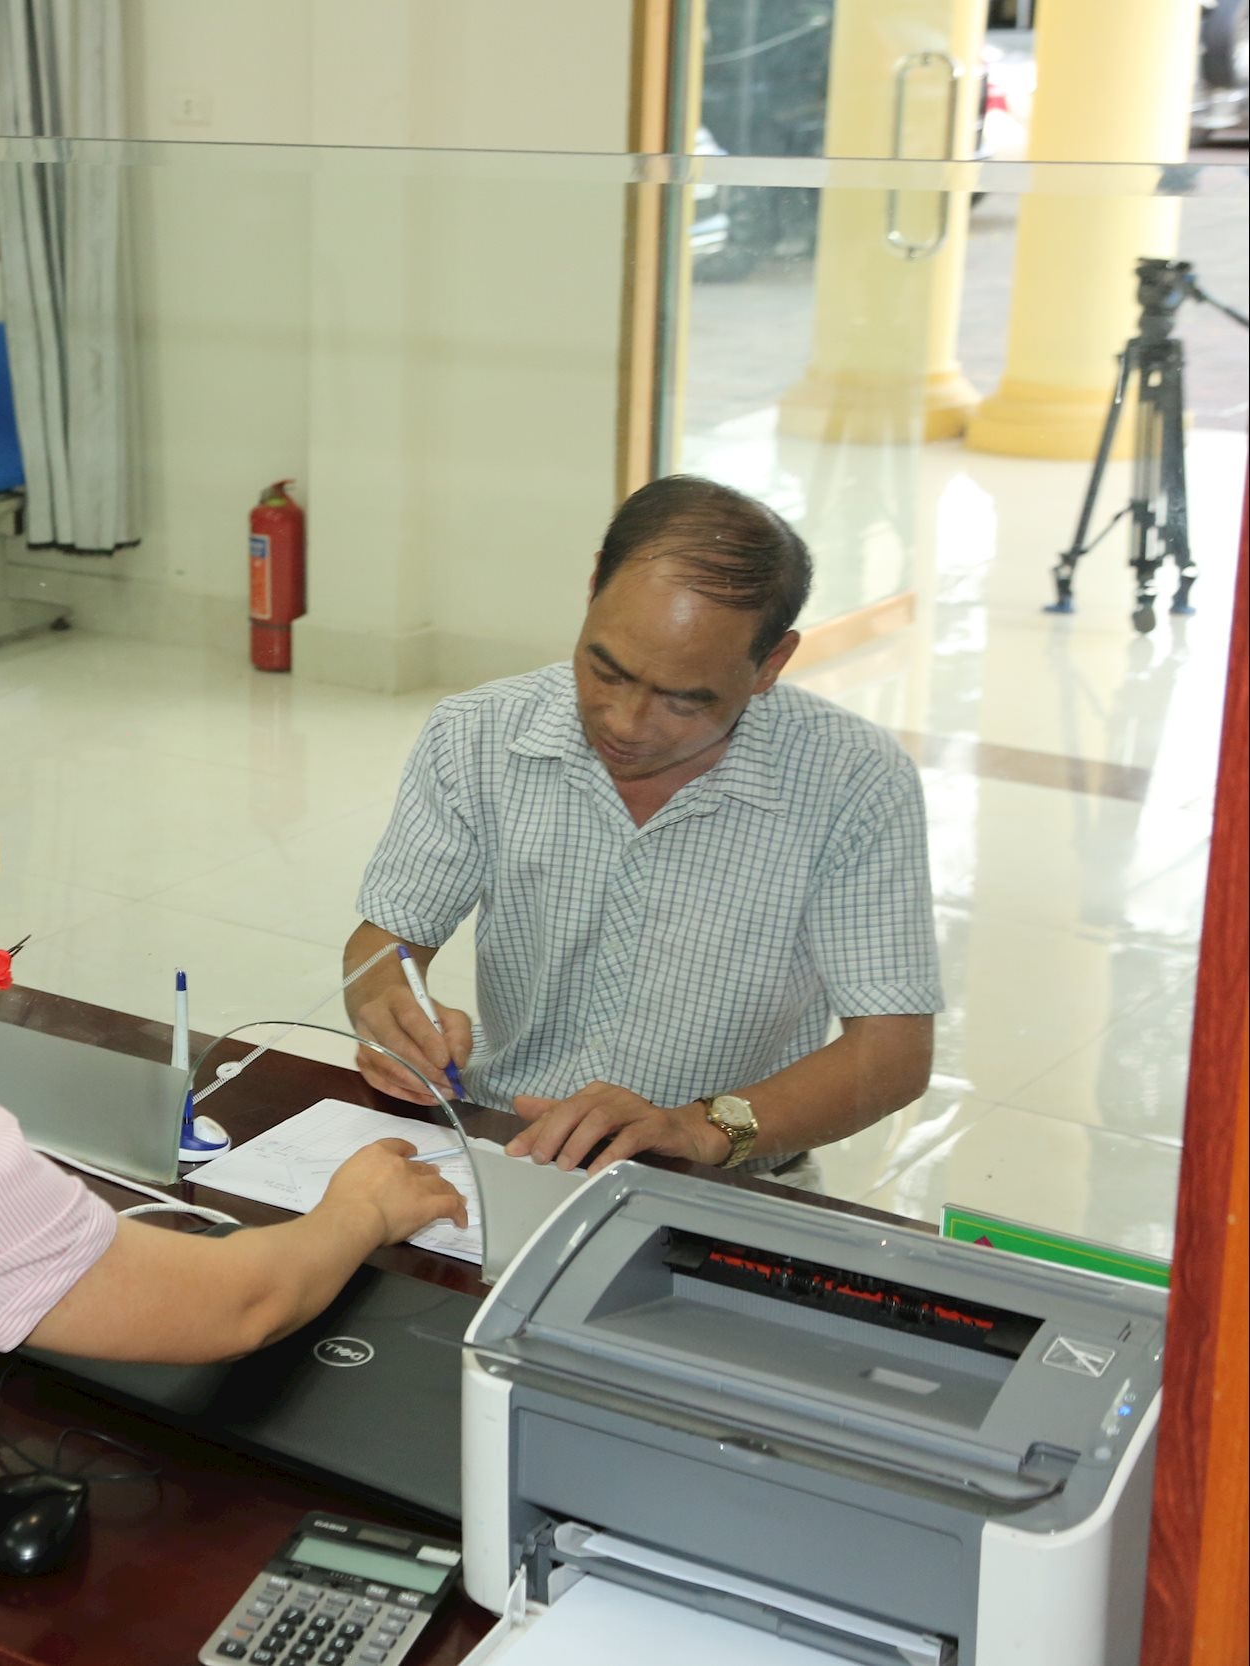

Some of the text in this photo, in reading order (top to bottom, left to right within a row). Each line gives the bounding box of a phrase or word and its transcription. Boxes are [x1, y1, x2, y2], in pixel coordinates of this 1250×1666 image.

[325, 1342, 366, 1361] DELL
[313, 1519, 349, 1533] CASIO
[287, 1609, 355, 1634] 7 8 9
[277, 1623, 345, 1648] 4 5 6
[226, 1642, 271, 1661] 0 00
[295, 1643, 307, 1654] 2
[324, 1651, 336, 1662] 3
